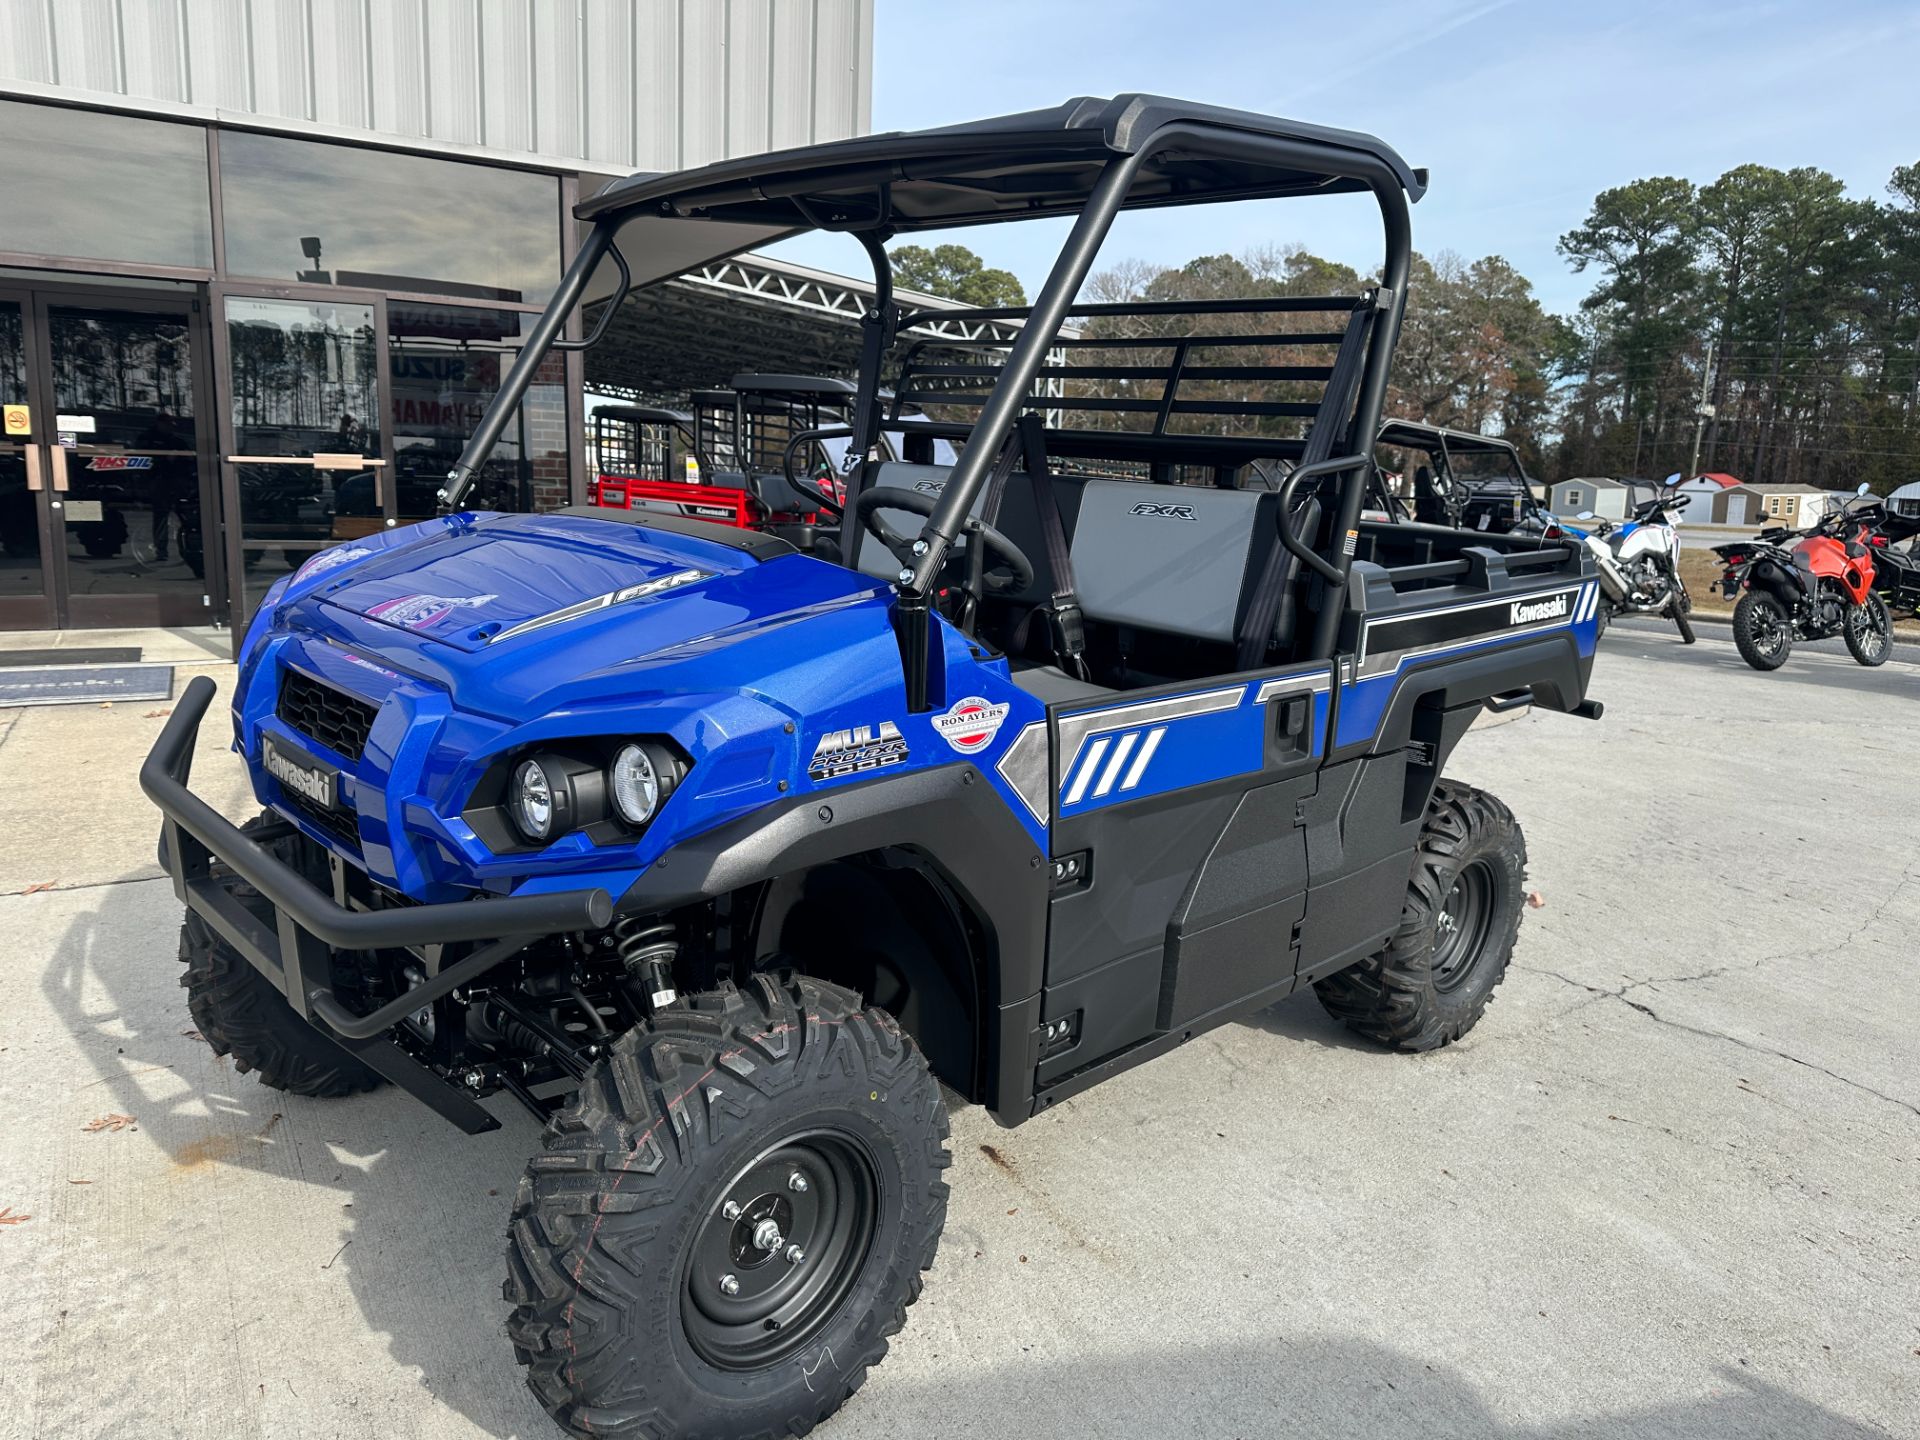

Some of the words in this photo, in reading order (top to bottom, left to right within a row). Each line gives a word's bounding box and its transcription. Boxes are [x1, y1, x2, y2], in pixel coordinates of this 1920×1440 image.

[86, 456, 152, 470] AMSOIL
[696, 506, 729, 517] Kawasaki
[1128, 502, 1197, 520] FXR
[613, 569, 709, 603] FXR
[1510, 594, 1567, 625] Kawasaki
[941, 716, 965, 727] RON
[967, 708, 1003, 722] AYERS
[812, 720, 905, 759] MULE
[807, 740, 907, 771] PRO-FXR
[822, 754, 900, 778] 1000
[263, 737, 330, 806] Kawasaki
